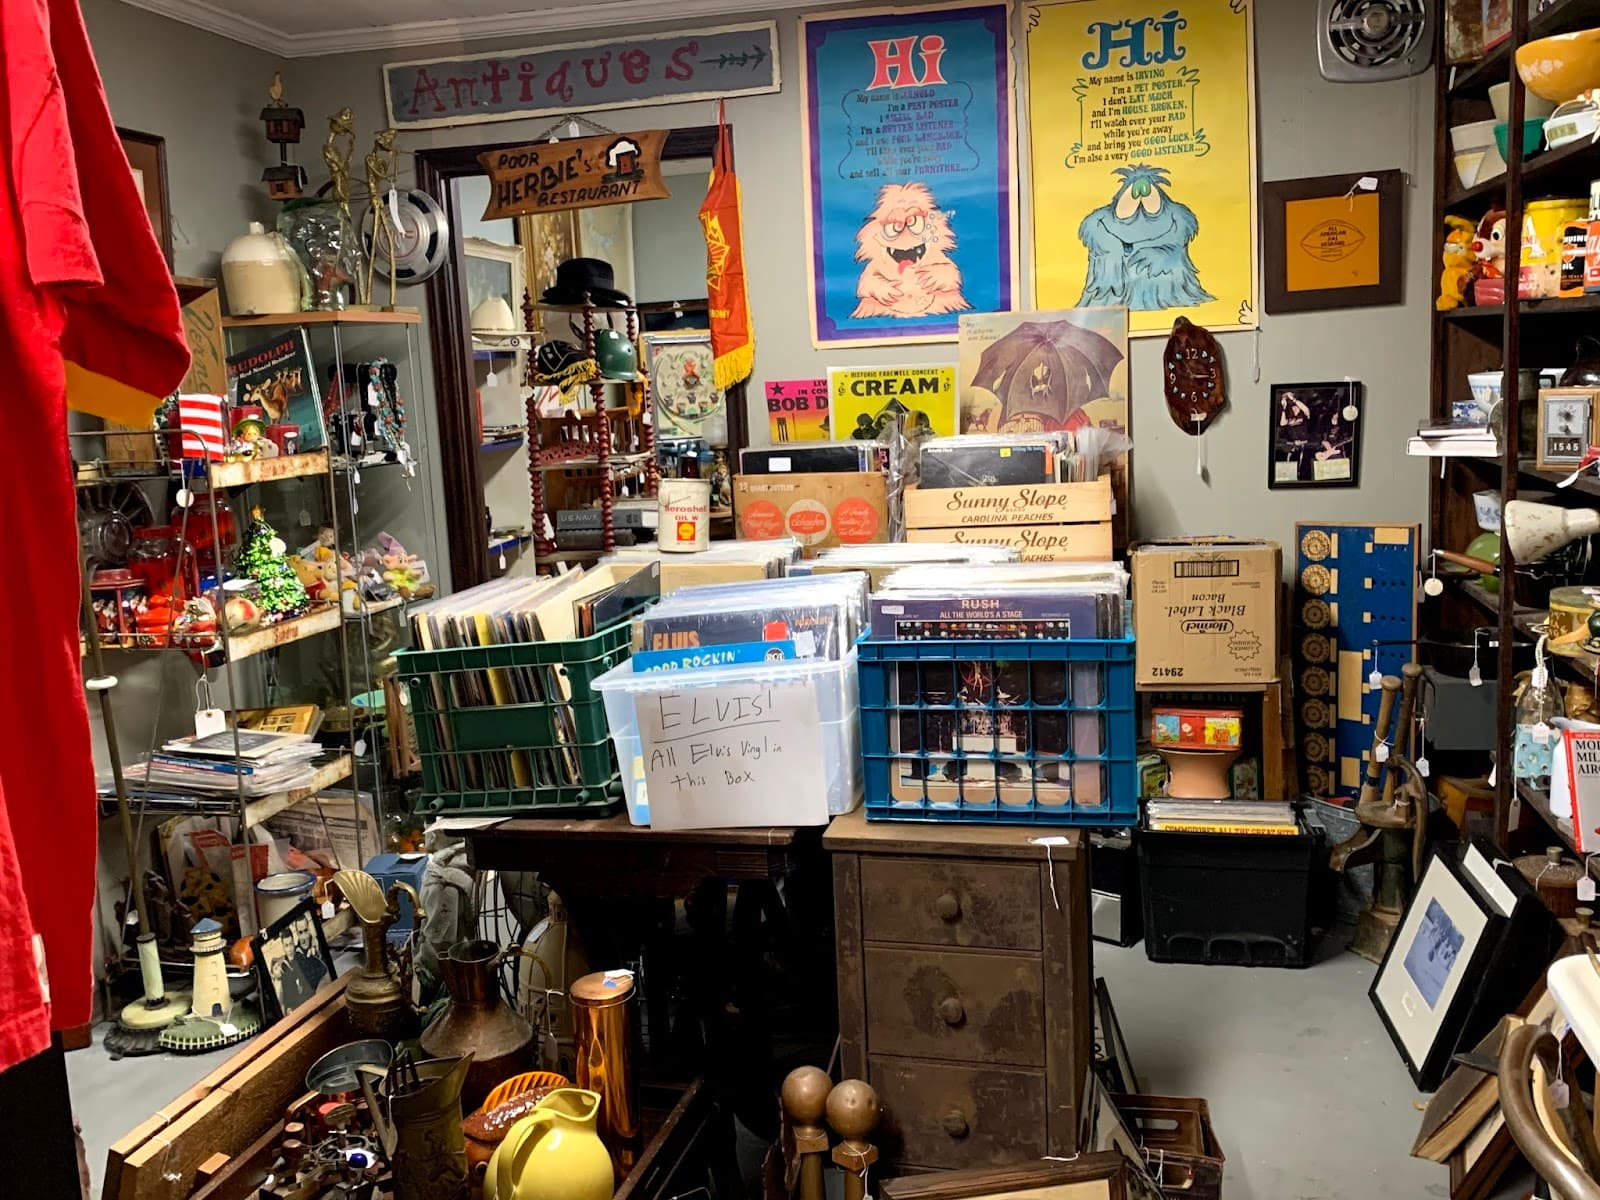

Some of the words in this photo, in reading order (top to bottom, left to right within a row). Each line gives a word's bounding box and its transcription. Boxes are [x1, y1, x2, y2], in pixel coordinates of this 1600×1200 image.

[866, 35, 948, 91] Hi
[408, 42, 698, 114] Antiques
[1089, 76, 1102, 86] My
[1104, 75, 1124, 84] name
[1126, 72, 1134, 81] is
[1135, 69, 1165, 80] IRVING
[1112, 86, 1125, 95] I'm
[1134, 83, 1149, 92] PET
[1108, 96, 1127, 105] don't
[1129, 94, 1145, 104] EAT
[1148, 91, 1173, 102] MUCH
[907, 101, 927, 110] PEST
[1092, 108, 1106, 118] and
[1108, 107, 1121, 116] I'm
[1122, 105, 1149, 114] HOUSE
[1091, 120, 1102, 128] I'll
[1103, 117, 1127, 127] watch
[1129, 118, 1146, 126] over
[1148, 115, 1166, 125] your
[1103, 128, 1125, 138] while
[1127, 127, 1150, 138] you're
[1152, 125, 1173, 134] away
[1087, 142, 1102, 151] and
[1104, 139, 1126, 151] bring
[1128, 140, 1142, 150] you
[1144, 136, 1166, 146] GOOD
[498, 152, 540, 170] POOR
[1073, 155, 1086, 163] I'm
[1087, 153, 1103, 163] also
[1111, 152, 1128, 162] very
[1130, 150, 1153, 159] GOOD
[537, 180, 641, 207] RESTAURANT
[227, 340, 295, 374] RUDOLPH
[1186, 348, 1198, 359] 12
[879, 369, 910, 377] FAREWELL
[1209, 367, 1217, 379] 3
[850, 377, 939, 396] CREAM
[1191, 391, 1198, 402] 6
[767, 397, 810, 413] BOB
[1553, 442, 1579, 451] 1545
[946, 490, 1010, 511] Sunny
[1012, 488, 1068, 510] Slope
[961, 514, 1008, 523] CAROLINA
[1011, 512, 1055, 521] PEACHES
[1014, 529, 1070, 551] Slope
[961, 599, 1000, 609] RUSH
[1191, 593, 1226, 603] Bacon
[939, 611, 951, 619] ALL
[952, 611, 966, 619] THE
[1167, 605, 1204, 617] Label
[1208, 605, 1246, 616] Black
[1185, 621, 1228, 632] Hormel
[1151, 667, 1184, 677] 29412
[1575, 740, 1600, 750] MO
[651, 746, 677, 772] All
[690, 743, 731, 765] Elvis
[773, 744, 782, 752] in
[1577, 764, 1600, 774] AIR
[670, 771, 706, 791] this
[724, 770, 755, 785] Box
